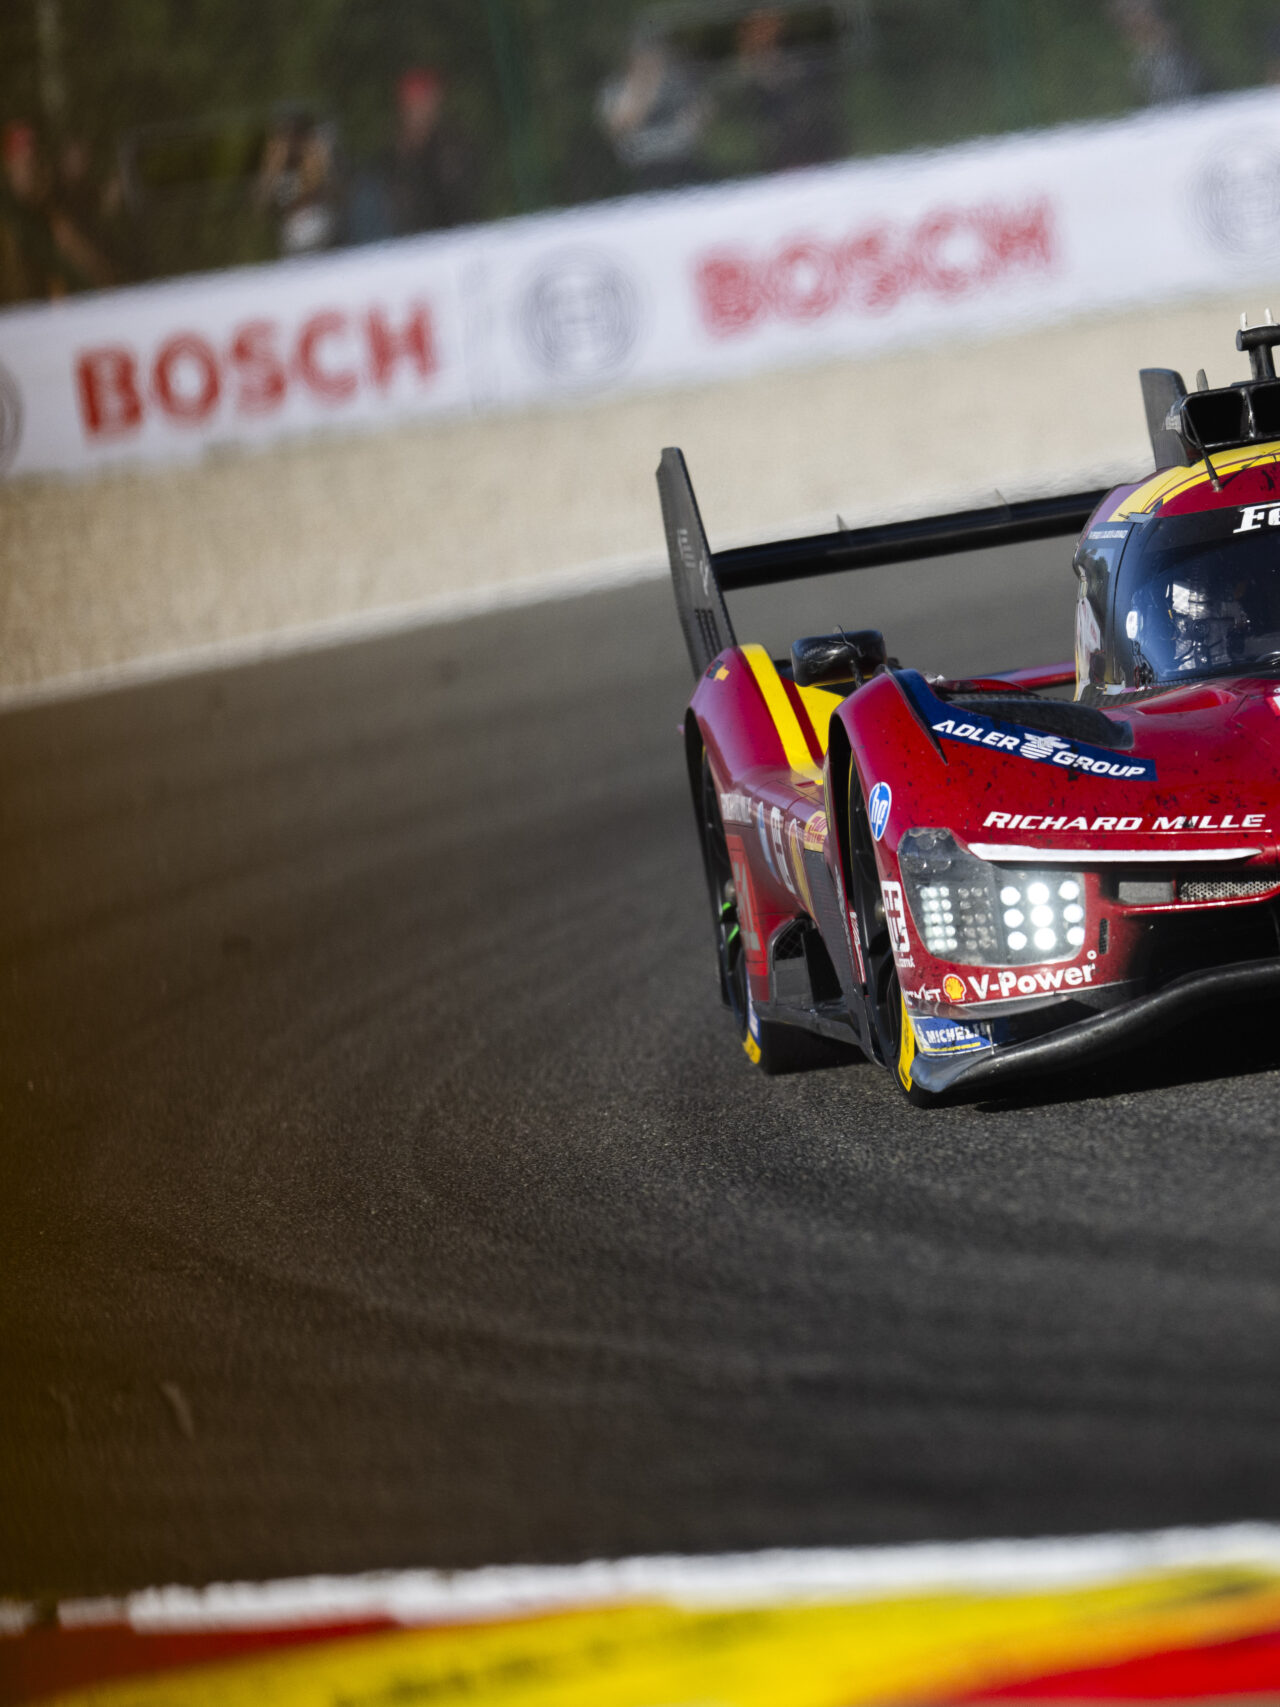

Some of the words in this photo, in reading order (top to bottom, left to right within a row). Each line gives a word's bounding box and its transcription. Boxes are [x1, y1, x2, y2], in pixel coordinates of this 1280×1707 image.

[694, 197, 1058, 338] BOSCH
[74, 300, 440, 440] BOSCH
[932, 719, 1021, 751] ADLER
[1052, 750, 1146, 778] GROUP
[982, 811, 1145, 831] RICHARD
[1152, 814, 1267, 830] MILLE
[968, 964, 1097, 1000] V-Power
